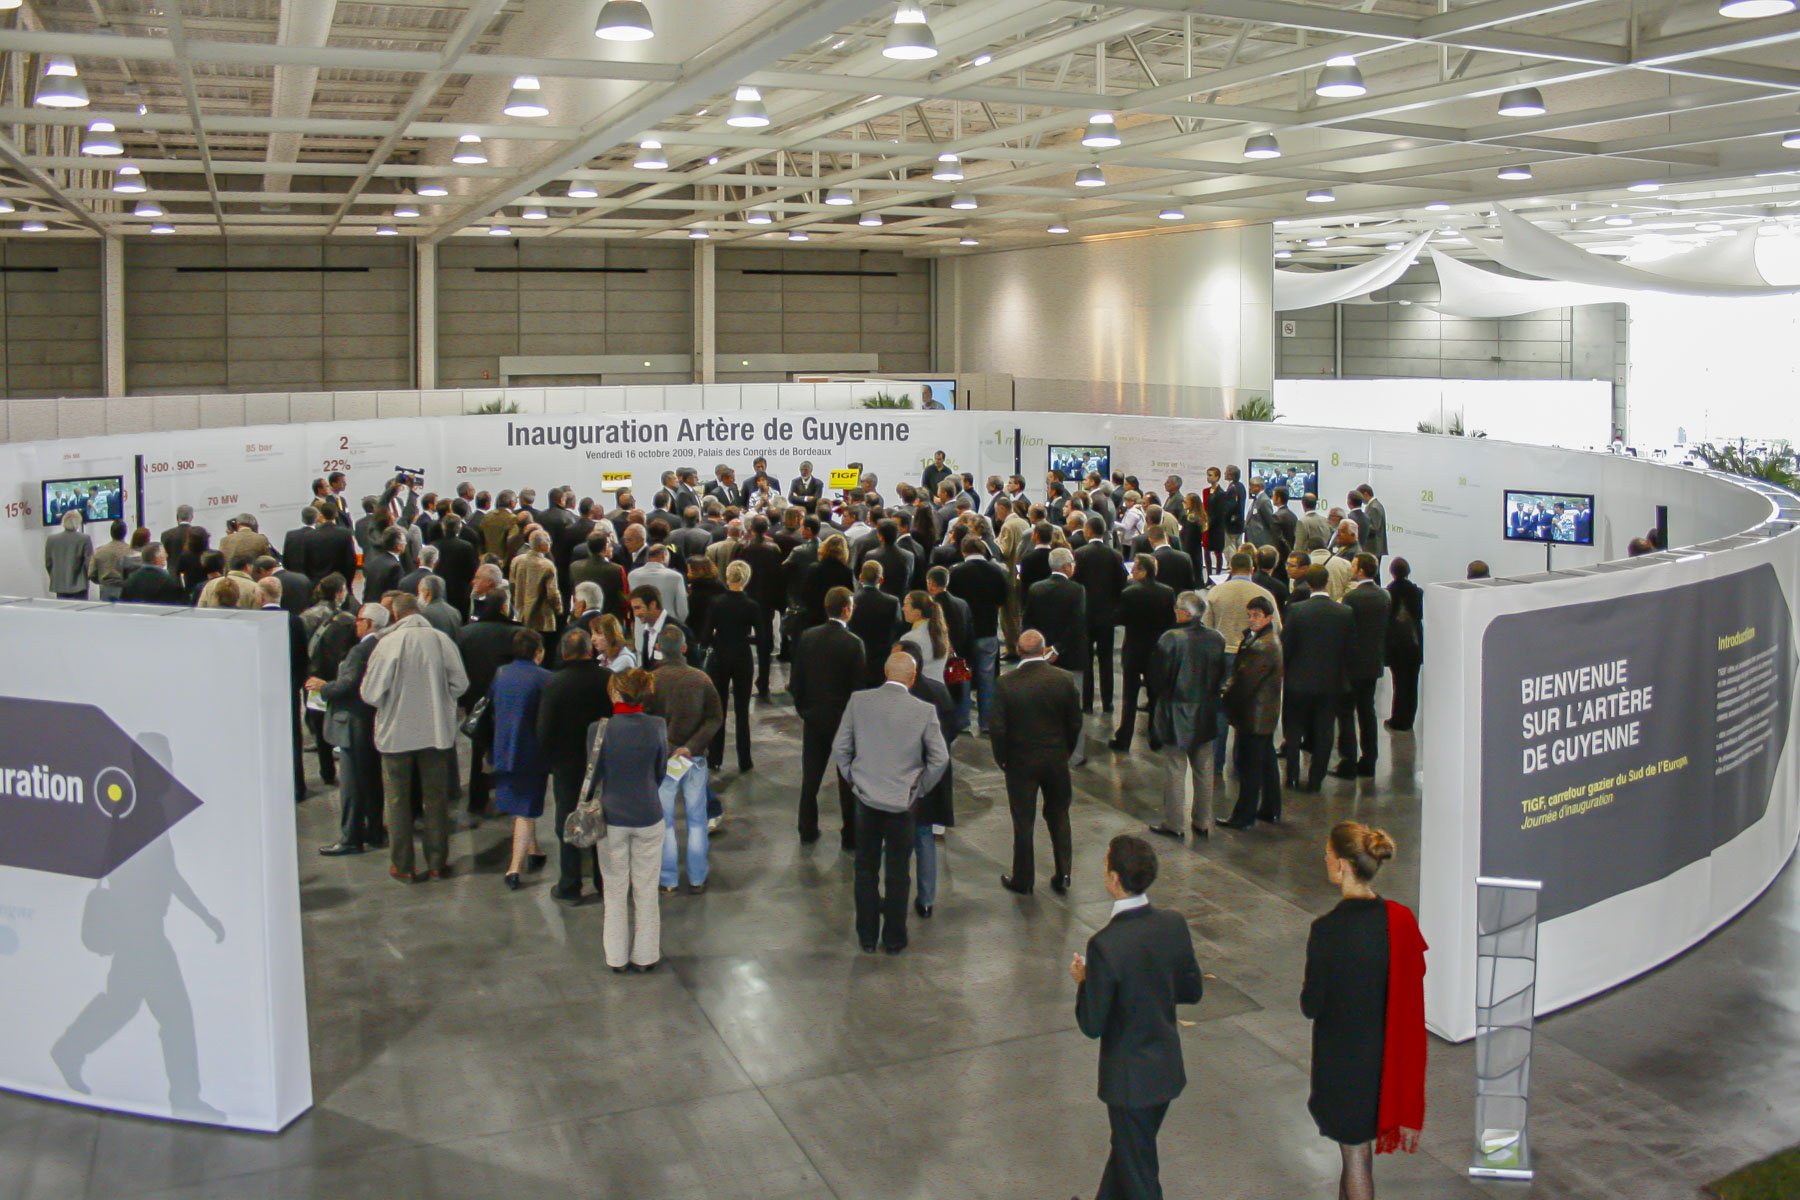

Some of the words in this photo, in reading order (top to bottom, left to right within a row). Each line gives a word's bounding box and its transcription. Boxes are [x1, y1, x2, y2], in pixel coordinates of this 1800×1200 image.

[507, 419, 668, 450] Inauguration
[676, 416, 754, 442] Artère
[763, 417, 793, 441] de
[802, 416, 909, 445] Guyenne
[340, 436, 349, 449] 2
[586, 450, 623, 459] Vendredi
[626, 450, 636, 458] 16
[638, 449, 670, 458] octobre
[673, 448, 696, 458] 2009,
[698, 448, 723, 457] Palais
[725, 448, 741, 456] des
[743, 447, 777, 457] Congrès
[780, 447, 790, 456] de
[792, 447, 832, 456] Bordeaux
[1331, 452, 1339, 466] 8
[151, 462, 169, 473] 500
[177, 460, 194, 471] 900
[323, 459, 351, 471] 22%
[456, 465, 467, 473] 20
[830, 471, 857, 480] TIGF
[208, 496, 219, 506] 70
[221, 494, 239, 505] MW
[1421, 490, 1434, 503] 28
[5, 500, 32, 519] 15%
[1521, 659, 1628, 705] BIENVENUE
[1522, 707, 1561, 740] SUR
[1565, 686, 1653, 729] L'ARTÈRE
[1523, 743, 1548, 774] DE
[1551, 721, 1640, 765] GUYENNE
[1521, 796, 1546, 814] TIGF,
[1548, 786, 1586, 807] carrefour
[1588, 777, 1614, 797] gazier
[1616, 773, 1627, 786] du
[1628, 766, 1644, 782] Sud
[1645, 764, 1657, 777] de
[1520, 809, 1558, 830] Journée
[1559, 792, 1614, 819] d'inauguration
